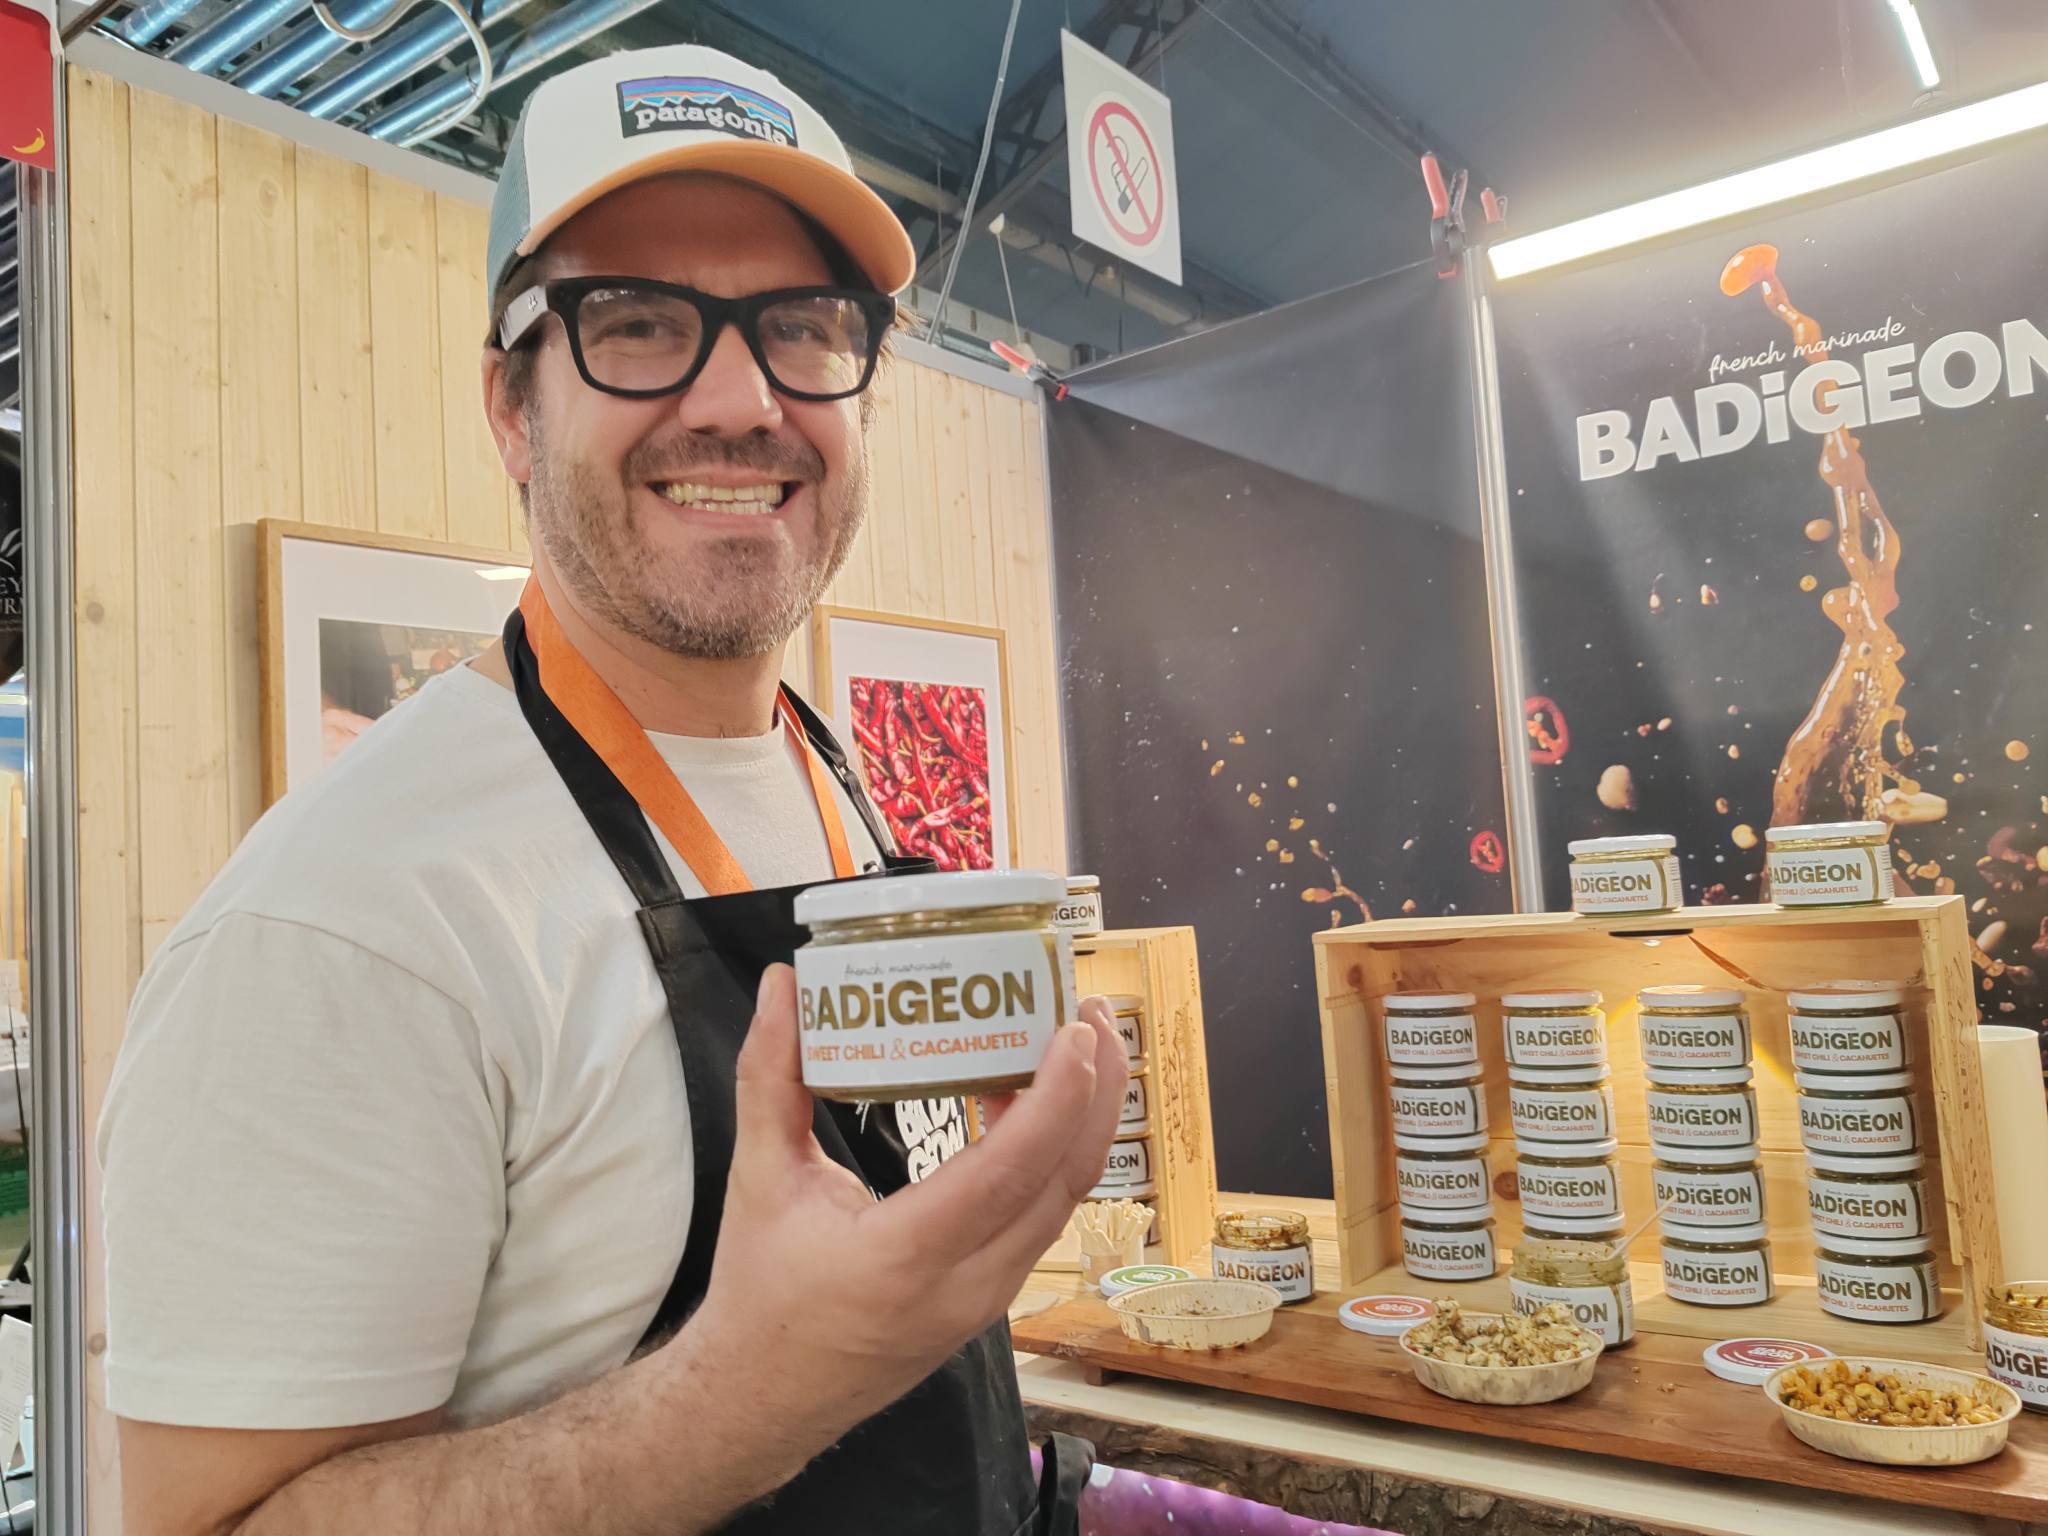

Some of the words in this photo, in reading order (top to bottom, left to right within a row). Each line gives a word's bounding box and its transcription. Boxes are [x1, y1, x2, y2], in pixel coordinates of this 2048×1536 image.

[635, 105, 788, 145] patagonia
[1708, 340, 1786, 382] french
[1793, 316, 1905, 358] marinade
[1572, 873, 1652, 894] ADiGEON
[800, 969, 1035, 1032] BADiGEON
[844, 1043, 885, 1061] CHILI
[890, 1037, 907, 1062] &
[909, 1030, 1029, 1057] CACAHUETES
[1391, 1028, 1473, 1046] BADiGEON
[1515, 1025, 1602, 1047] BADiGEON
[1791, 1029, 1892, 1050] BADiGEON
[1801, 1108, 1904, 1132] BADiGEON
[1520, 1175, 1606, 1198] BADiGEON
[1404, 1238, 1486, 1261] BADiGEON
[1217, 1260, 1305, 1282] BADiGEON
[1664, 1259, 1759, 1285] BADiGEON
[1818, 1272, 1912, 1301] ADiGEON
